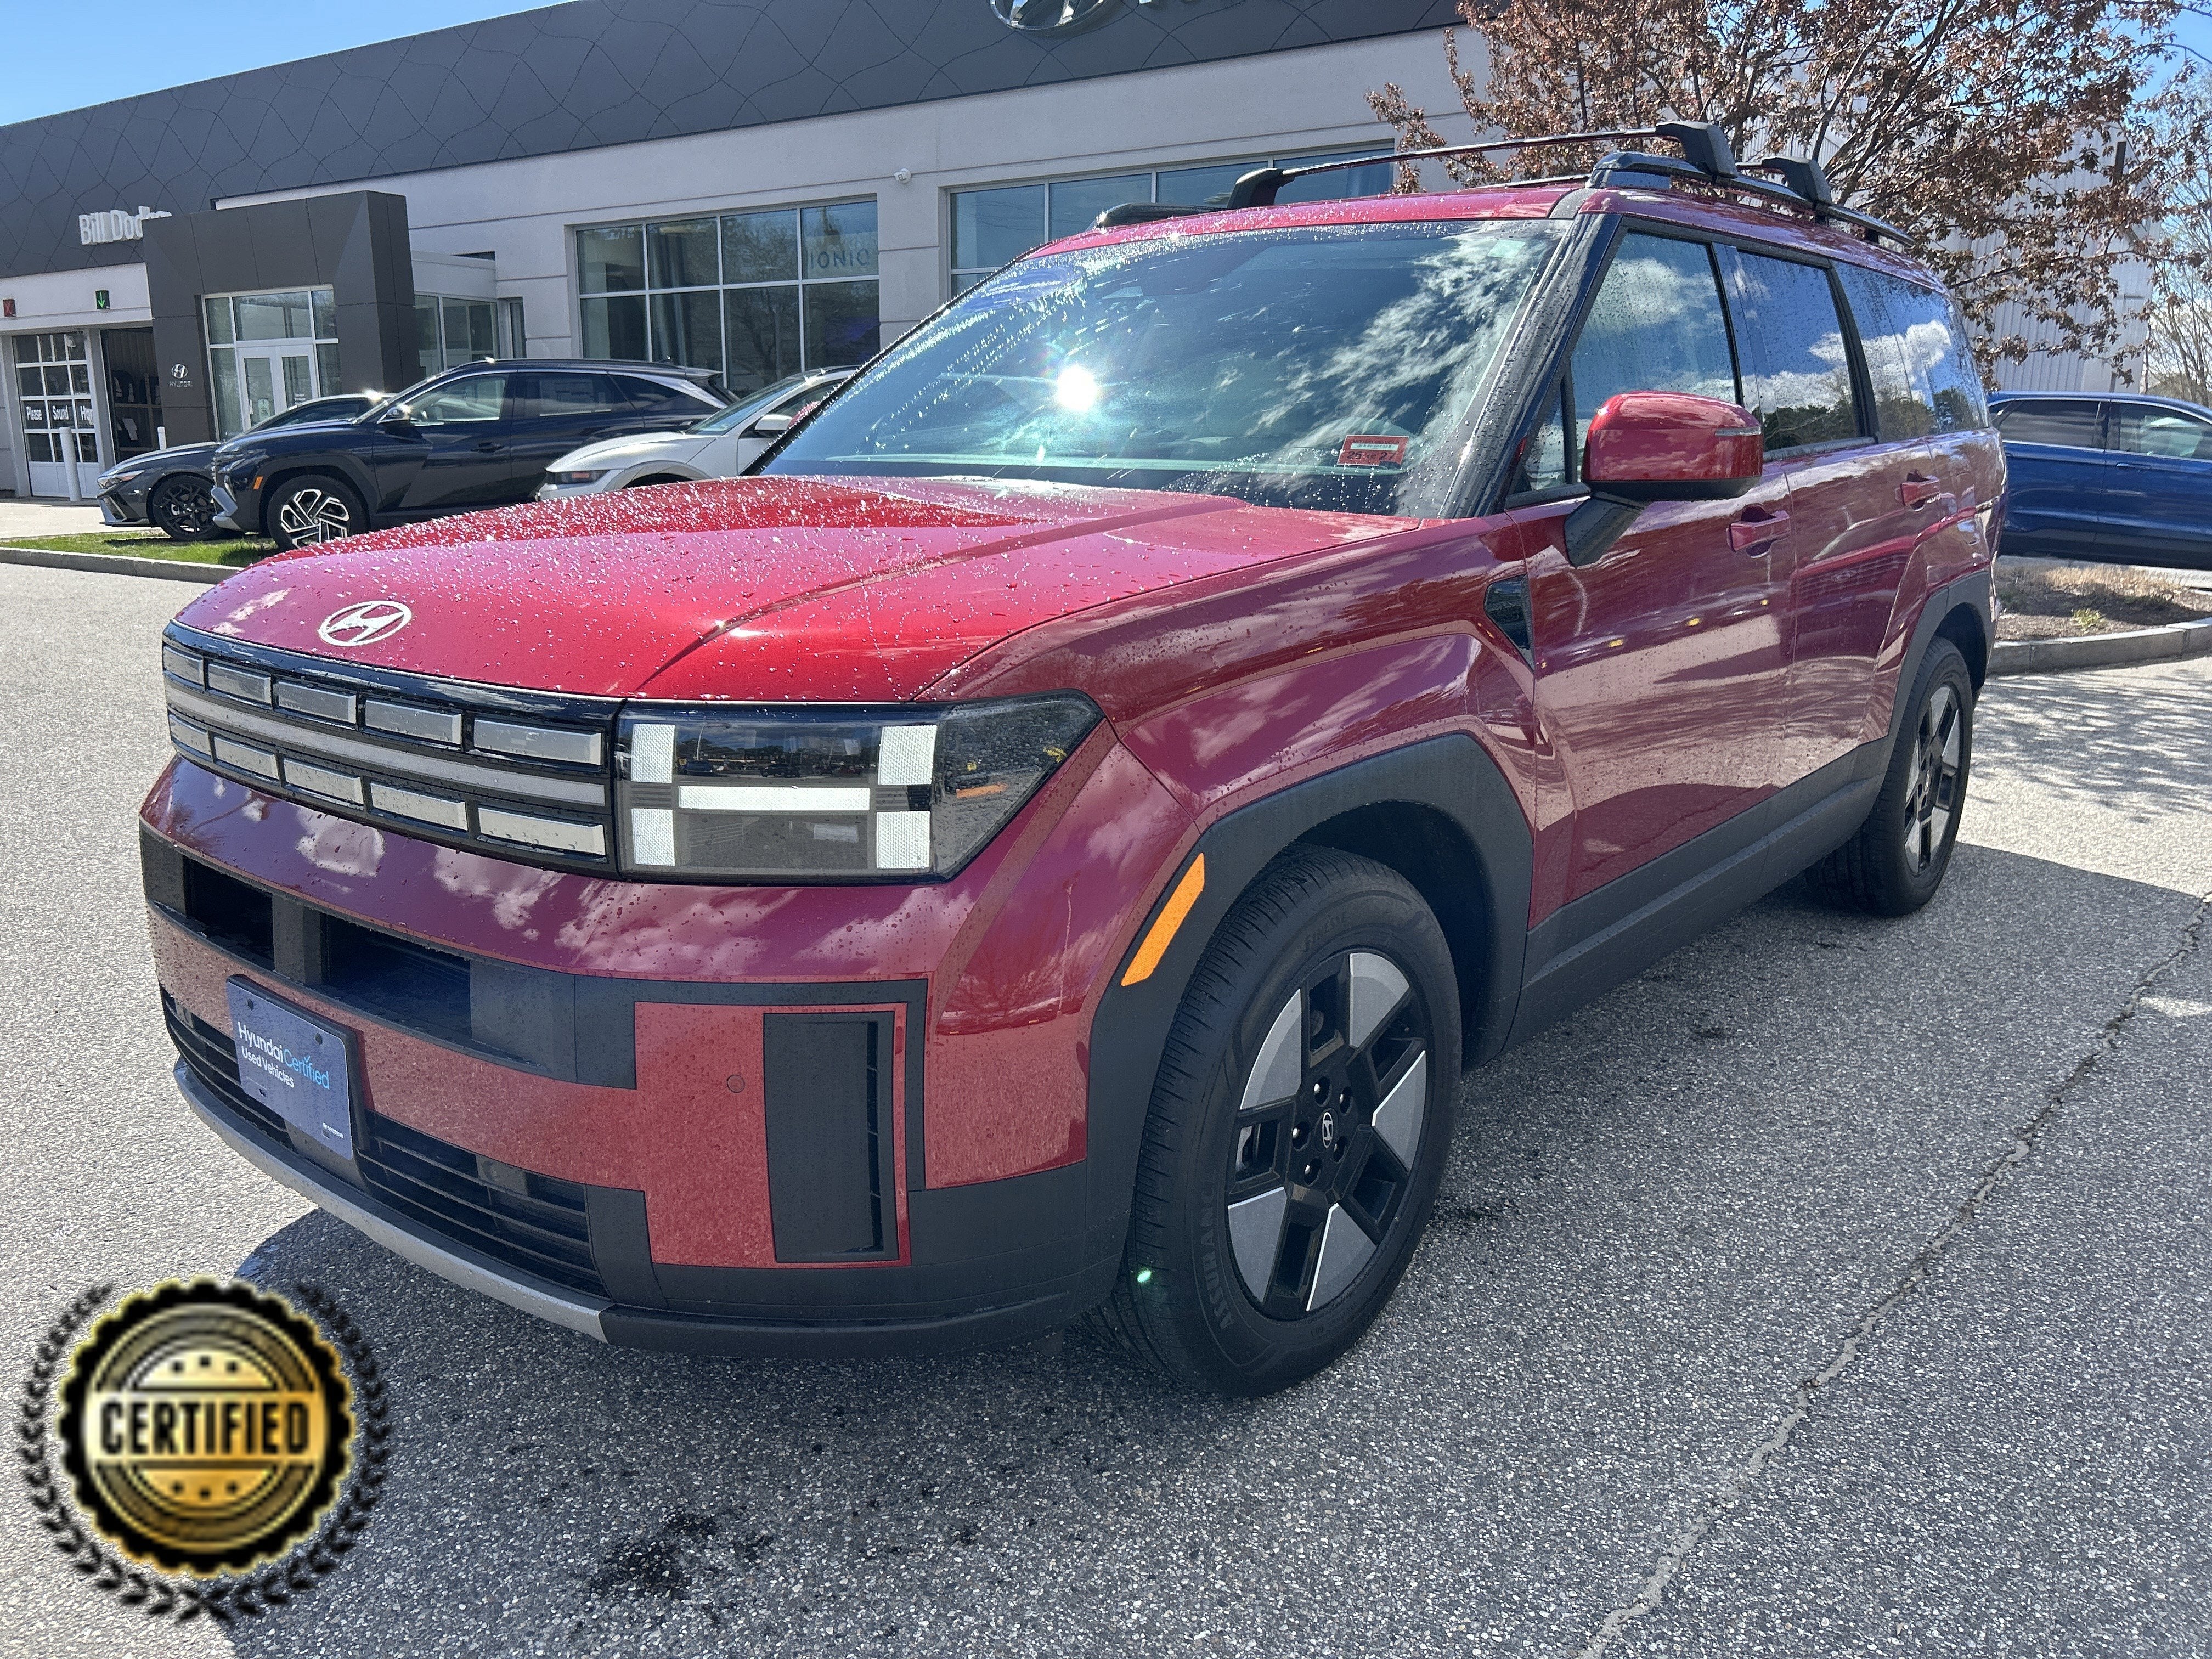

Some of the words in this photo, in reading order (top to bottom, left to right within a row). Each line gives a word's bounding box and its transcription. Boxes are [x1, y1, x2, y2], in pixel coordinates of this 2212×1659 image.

[78, 211, 113, 245] Bill
[810, 248, 870, 269] IONIQ
[26, 405, 42, 421] Please
[52, 405, 69, 421] Sound
[237, 1021, 284, 1063] Hyundai
[283, 1048, 330, 1090] Certified
[241, 1045, 262, 1068] Used
[262, 1056, 295, 1088] Vehicles
